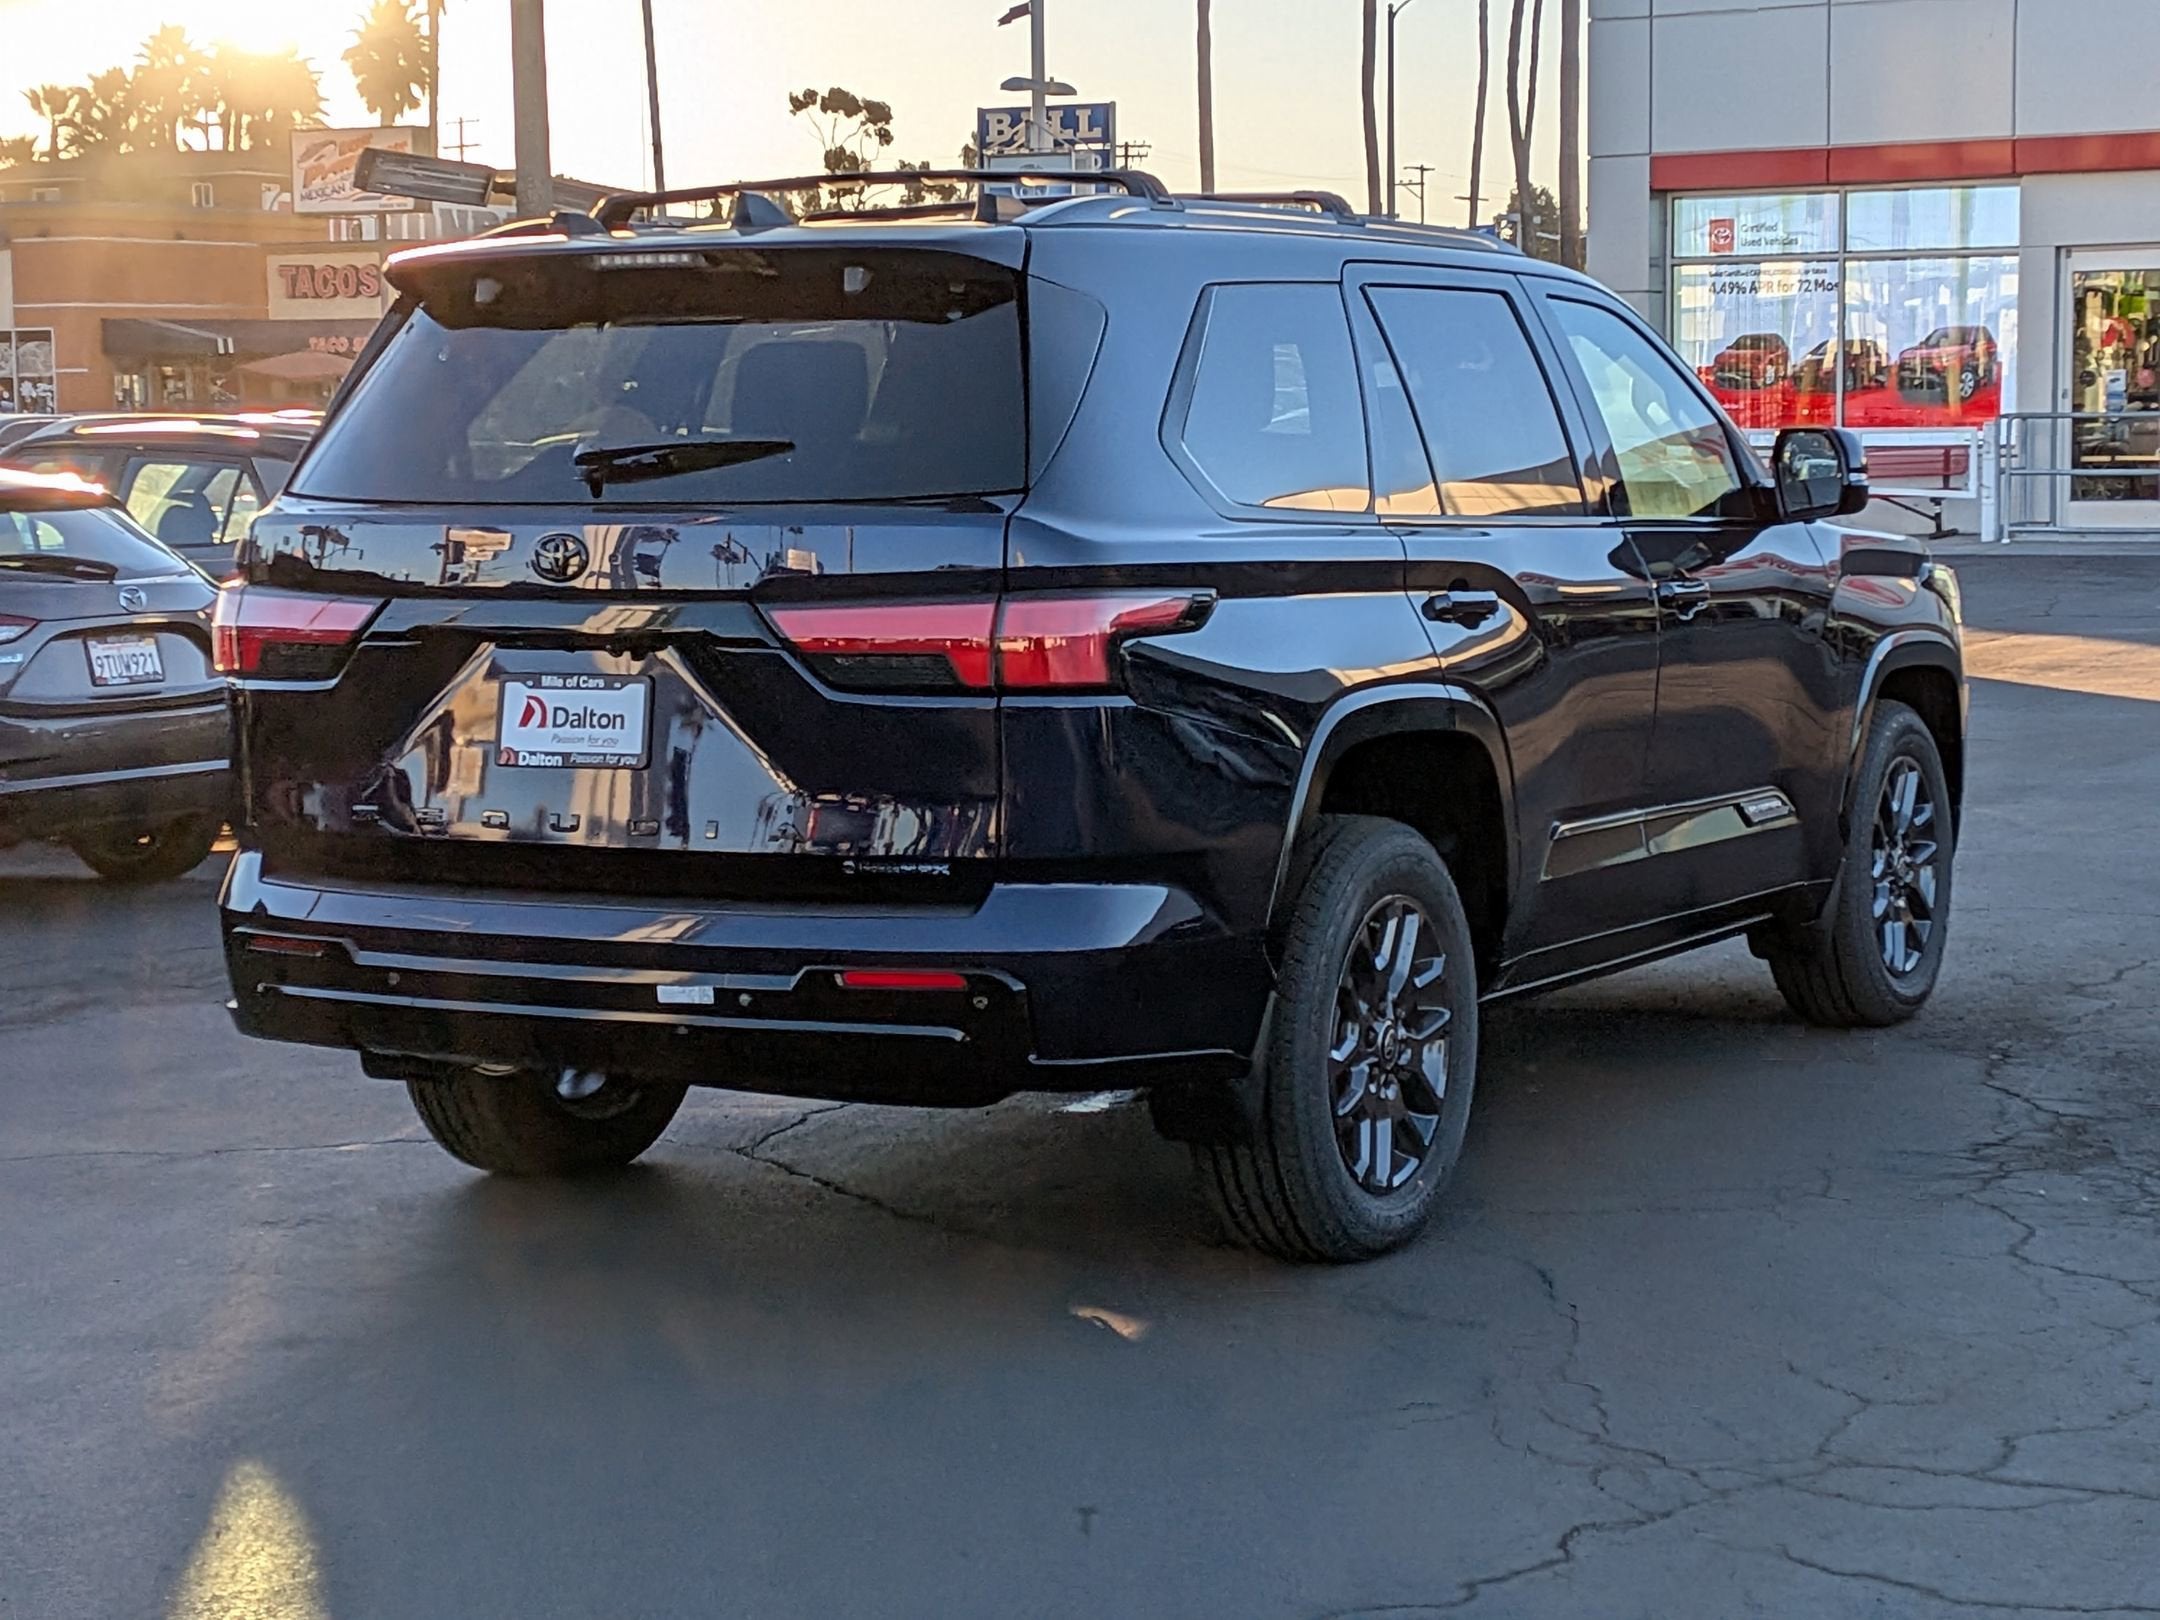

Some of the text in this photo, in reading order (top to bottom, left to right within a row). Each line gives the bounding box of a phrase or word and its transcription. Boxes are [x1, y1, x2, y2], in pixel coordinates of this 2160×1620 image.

[301, 181, 346, 200] MEXICAN
[1740, 222, 1778, 233] Certified
[1740, 238, 1761, 247] Used
[277, 263, 381, 299] TACOS
[1748, 280, 1774, 294] APR
[1776, 279, 1796, 293] for
[1797, 278, 1812, 293] 72
[308, 336, 350, 352] TACO
[541, 675, 605, 688] Mile of Cars
[551, 705, 625, 730] Dalton
[550, 733, 620, 746] Passion for you
[518, 751, 638, 767] Dalton Passion for you
